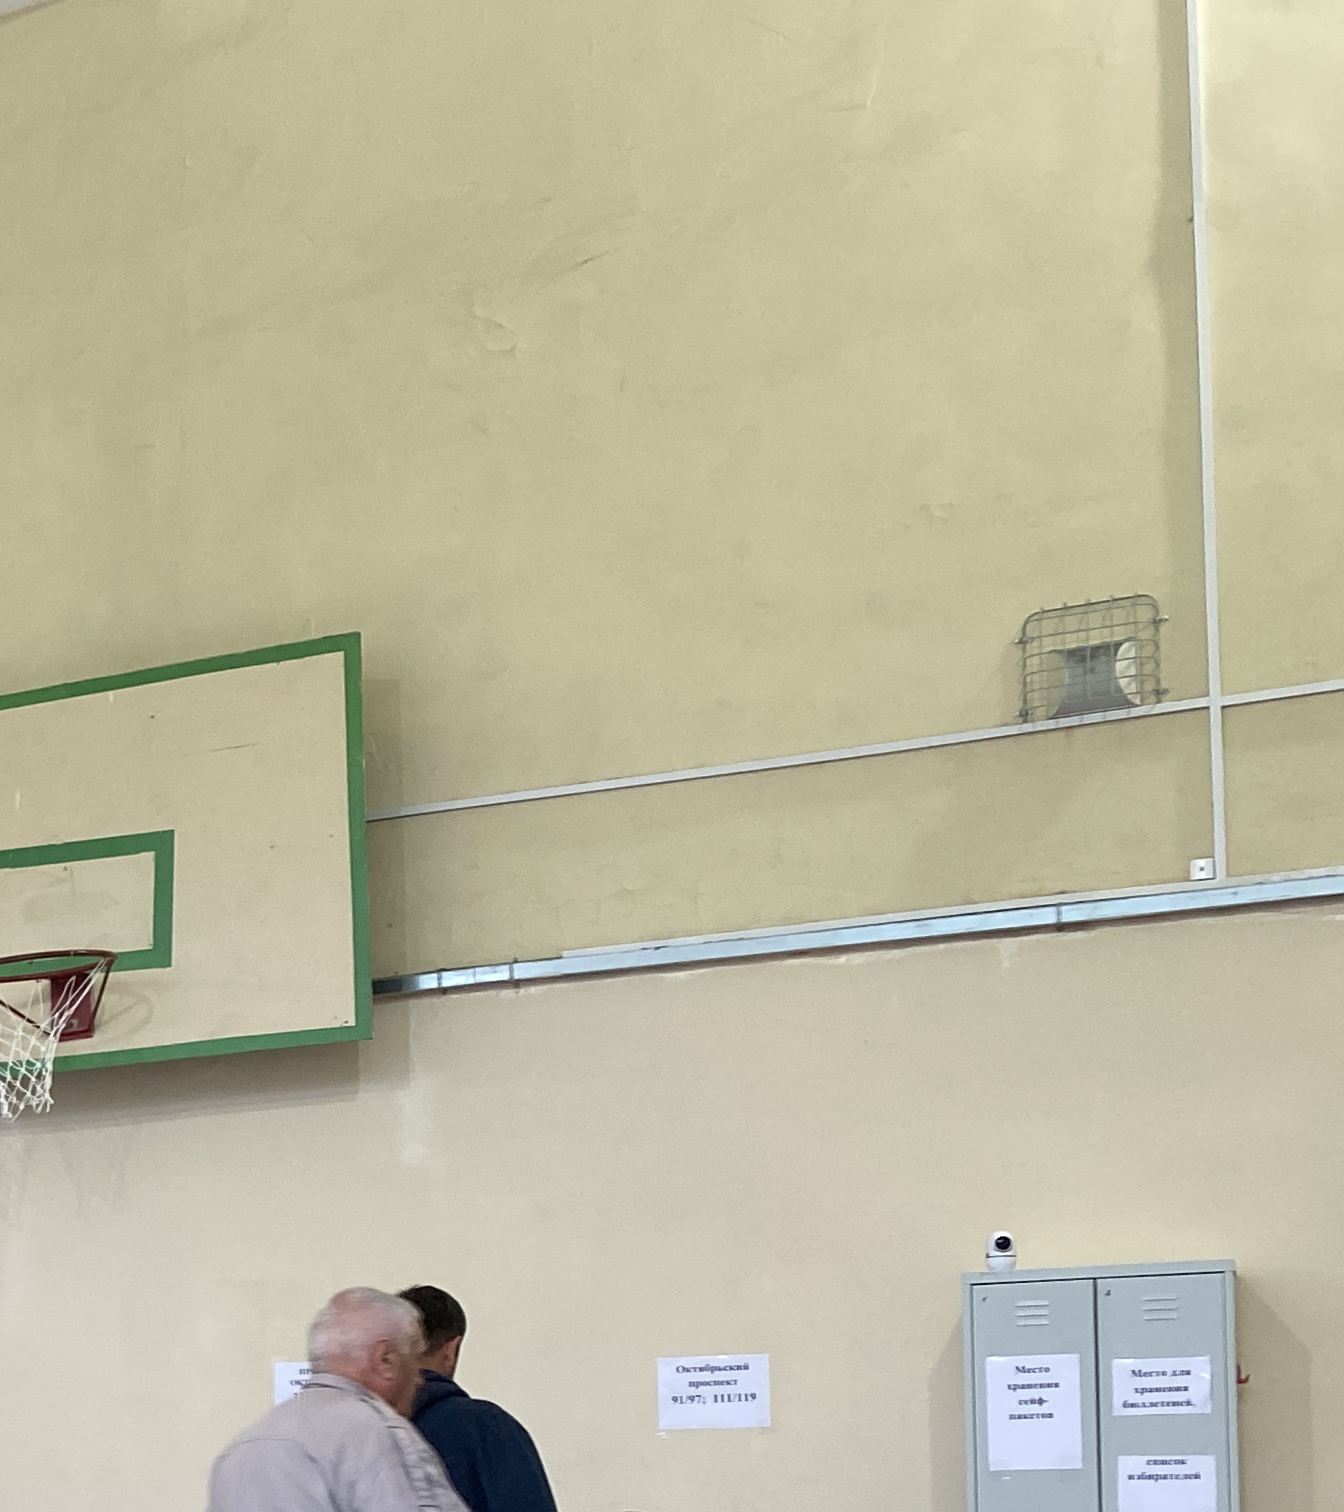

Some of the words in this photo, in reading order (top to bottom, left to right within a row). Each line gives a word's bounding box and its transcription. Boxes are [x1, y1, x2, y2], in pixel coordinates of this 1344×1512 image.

[675, 1363, 750, 1374] Октябрьский
[1014, 1365, 1051, 1375] Место
[1130, 1369, 1168, 1378] Место
[688, 1379, 738, 1389] проспект
[713, 1392, 757, 1403] 111/119
